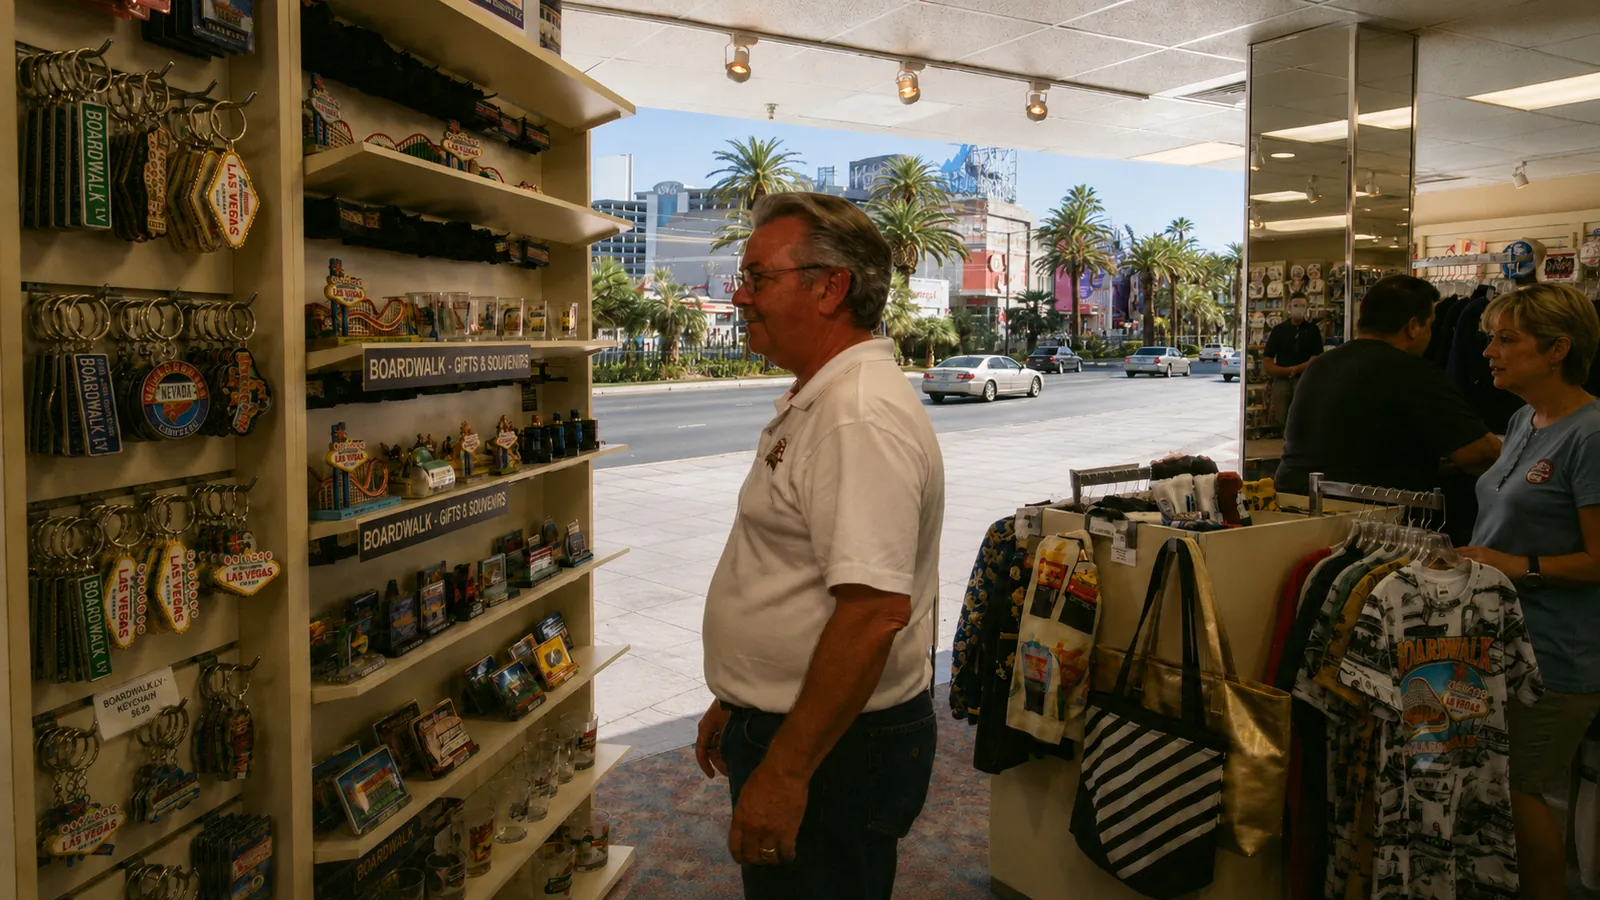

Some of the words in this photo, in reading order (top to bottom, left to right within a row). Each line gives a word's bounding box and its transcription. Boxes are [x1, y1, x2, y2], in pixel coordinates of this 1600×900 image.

[86, 109, 105, 203] BOARDWALK
[227, 163, 237, 189] LAS
[95, 207, 107, 222] LV
[228, 194, 240, 236] VEGAS
[369, 356, 446, 380] BOARDWALK
[454, 355, 479, 374] GIFTS
[480, 355, 486, 372] &
[487, 354, 529, 371] SOUVENIRS
[80, 358, 106, 434] BOARDWALK
[161, 383, 192, 400] NEVADA
[363, 512, 432, 551] BOARDWALK
[439, 504, 462, 526] GIFTS
[469, 491, 507, 517] SOUVENIRS
[170, 554, 181, 580] LAS
[226, 572, 243, 582] LAS
[245, 567, 273, 580] VEGAS
[118, 568, 129, 593] LAS
[172, 582, 184, 624] VEGAS
[83, 580, 106, 659] BOARDWALK
[118, 595, 129, 639] VEGAS
[103, 682, 154, 708] BOARDWALK
[117, 691, 157, 713] KEYCHAIN
[62, 835, 82, 851] LAS
[356, 823, 415, 882] BOARDWALK
